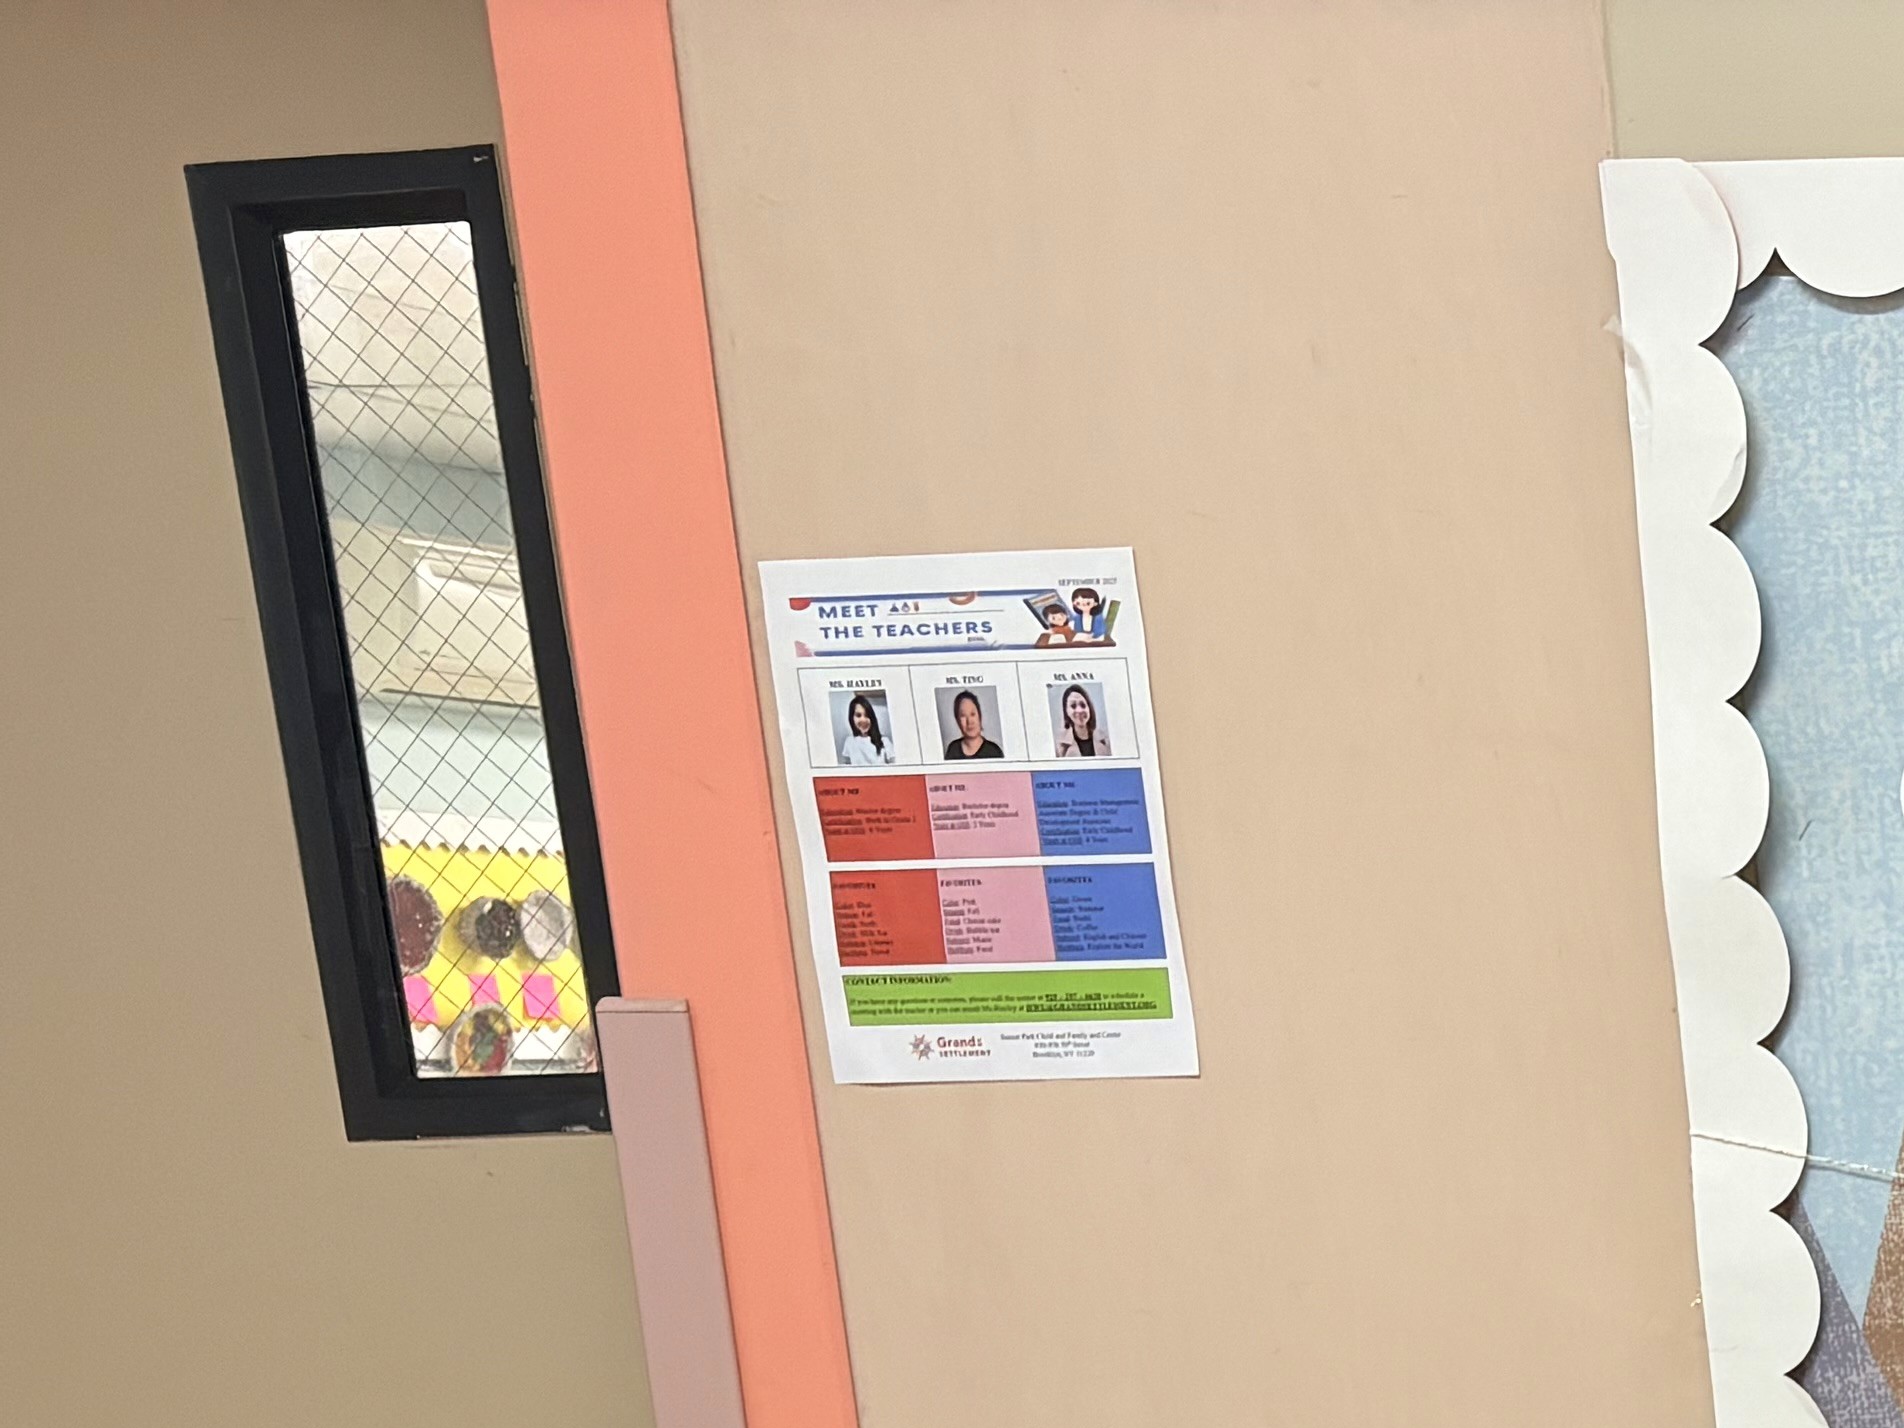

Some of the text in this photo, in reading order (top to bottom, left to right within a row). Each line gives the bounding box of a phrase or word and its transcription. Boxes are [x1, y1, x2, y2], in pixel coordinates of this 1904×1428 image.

[819, 604, 878, 619] MEET
[820, 620, 993, 639] THE TEACHERS
